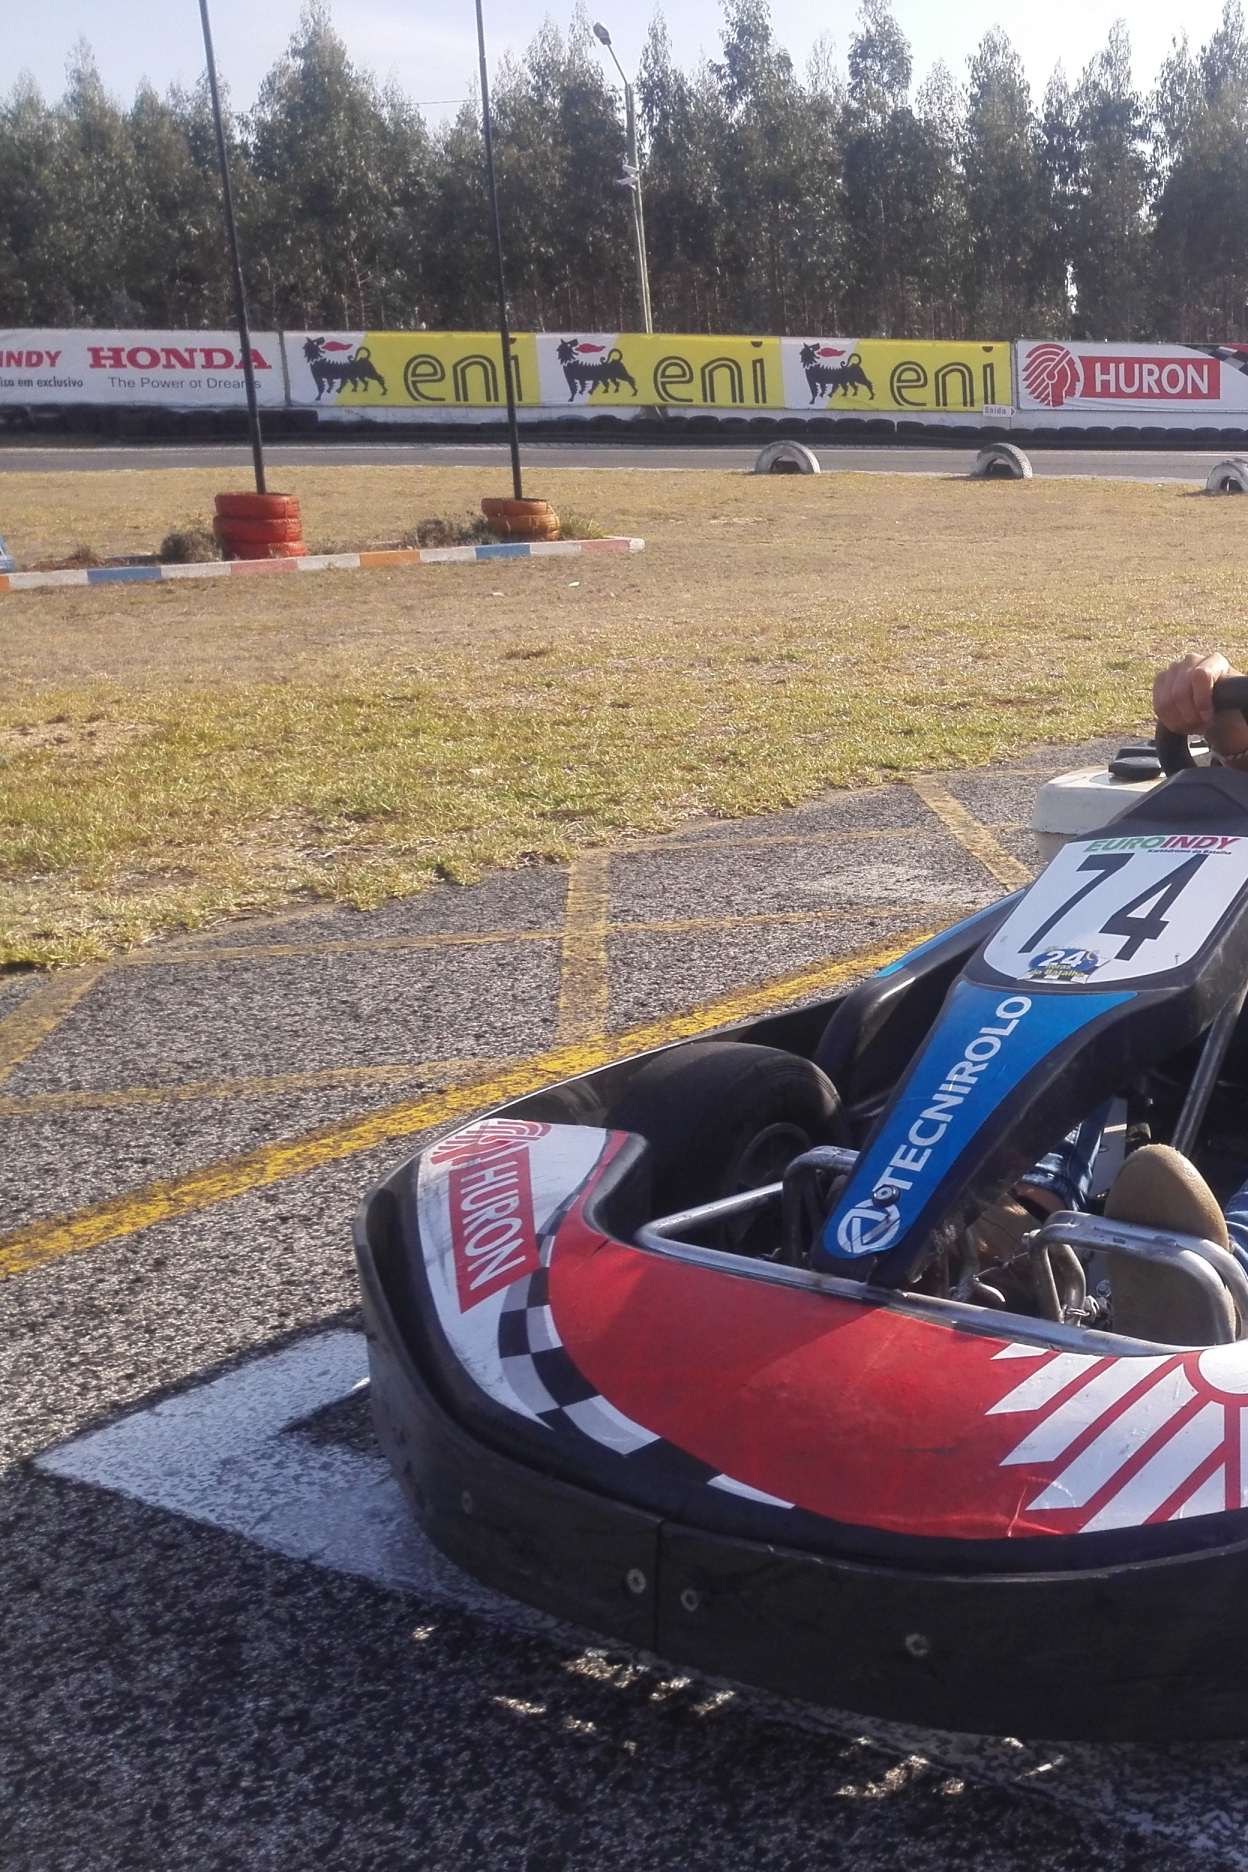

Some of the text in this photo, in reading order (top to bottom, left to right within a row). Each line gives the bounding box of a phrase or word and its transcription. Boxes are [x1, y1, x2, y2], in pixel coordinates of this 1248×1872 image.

[37, 375, 84, 388] exclusivo
[87, 346, 272, 370] HONDA
[403, 338, 523, 402] eni
[653, 341, 767, 404] eni
[889, 346, 996, 407] eni
[1094, 361, 1210, 395] HURON
[108, 376, 136, 389] The
[140, 377, 184, 389] Power
[1086, 836, 1241, 851] EUROINDY
[1018, 852, 1209, 961] 74
[1038, 950, 1087, 967] 24
[872, 996, 1032, 1191] TECNIROLO
[460, 1160, 527, 1291] HURON
